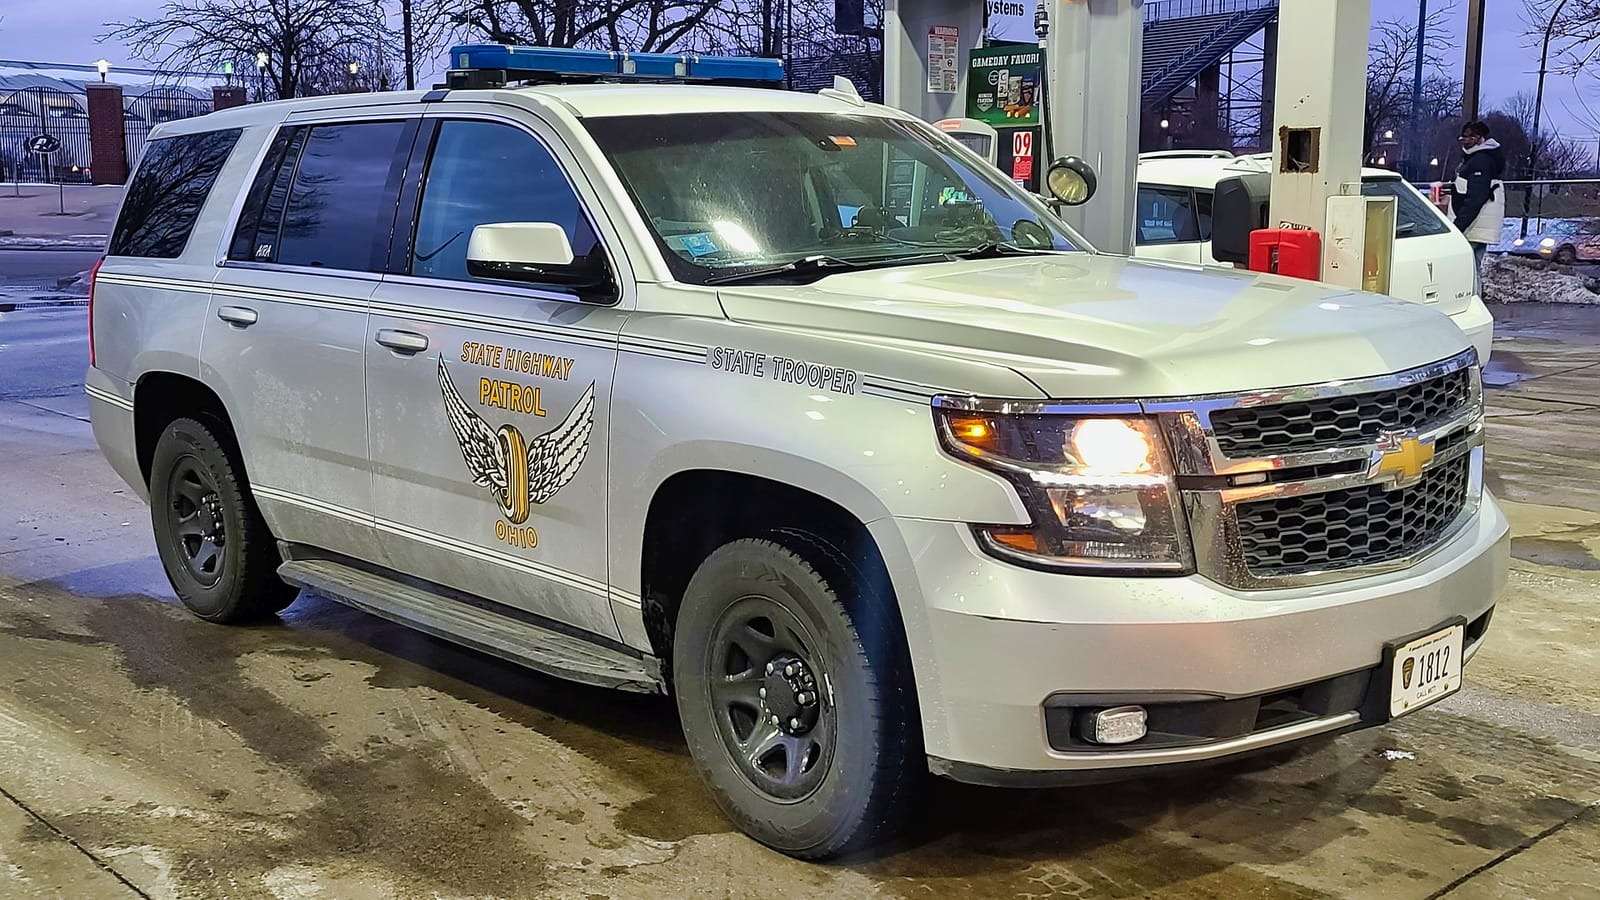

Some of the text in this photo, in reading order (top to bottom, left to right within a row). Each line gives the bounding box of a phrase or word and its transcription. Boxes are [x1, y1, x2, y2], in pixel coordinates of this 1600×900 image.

[988, 0, 1024, 17] ystems
[972, 55, 1009, 68] GAMEDAY
[1015, 133, 1031, 156] 09
[461, 341, 575, 381] STATE HIGHWAY
[712, 346, 857, 395] STATE TROOPER
[480, 377, 547, 417] PATROL
[495, 519, 538, 549] OHIO
[1418, 645, 1450, 688] 1812
